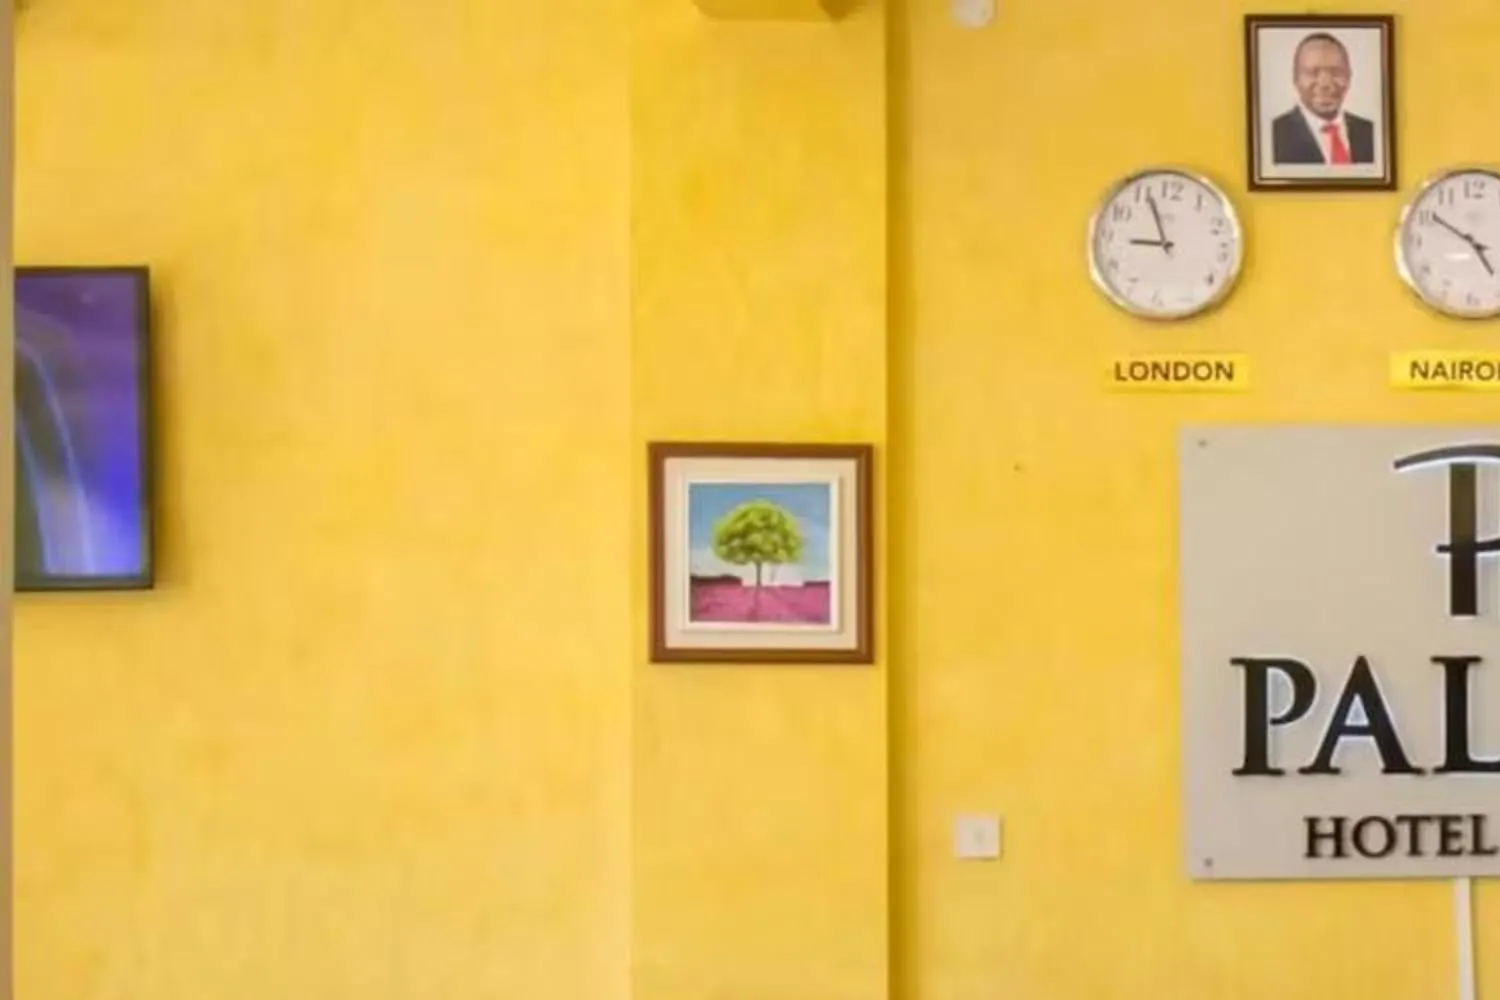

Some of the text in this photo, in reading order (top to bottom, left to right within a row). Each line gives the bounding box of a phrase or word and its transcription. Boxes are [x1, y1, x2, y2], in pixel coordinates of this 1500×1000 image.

[1161, 180, 1185, 201] 12
[1114, 361, 1234, 382] LONDON
[1304, 814, 1497, 859] HOTEL
